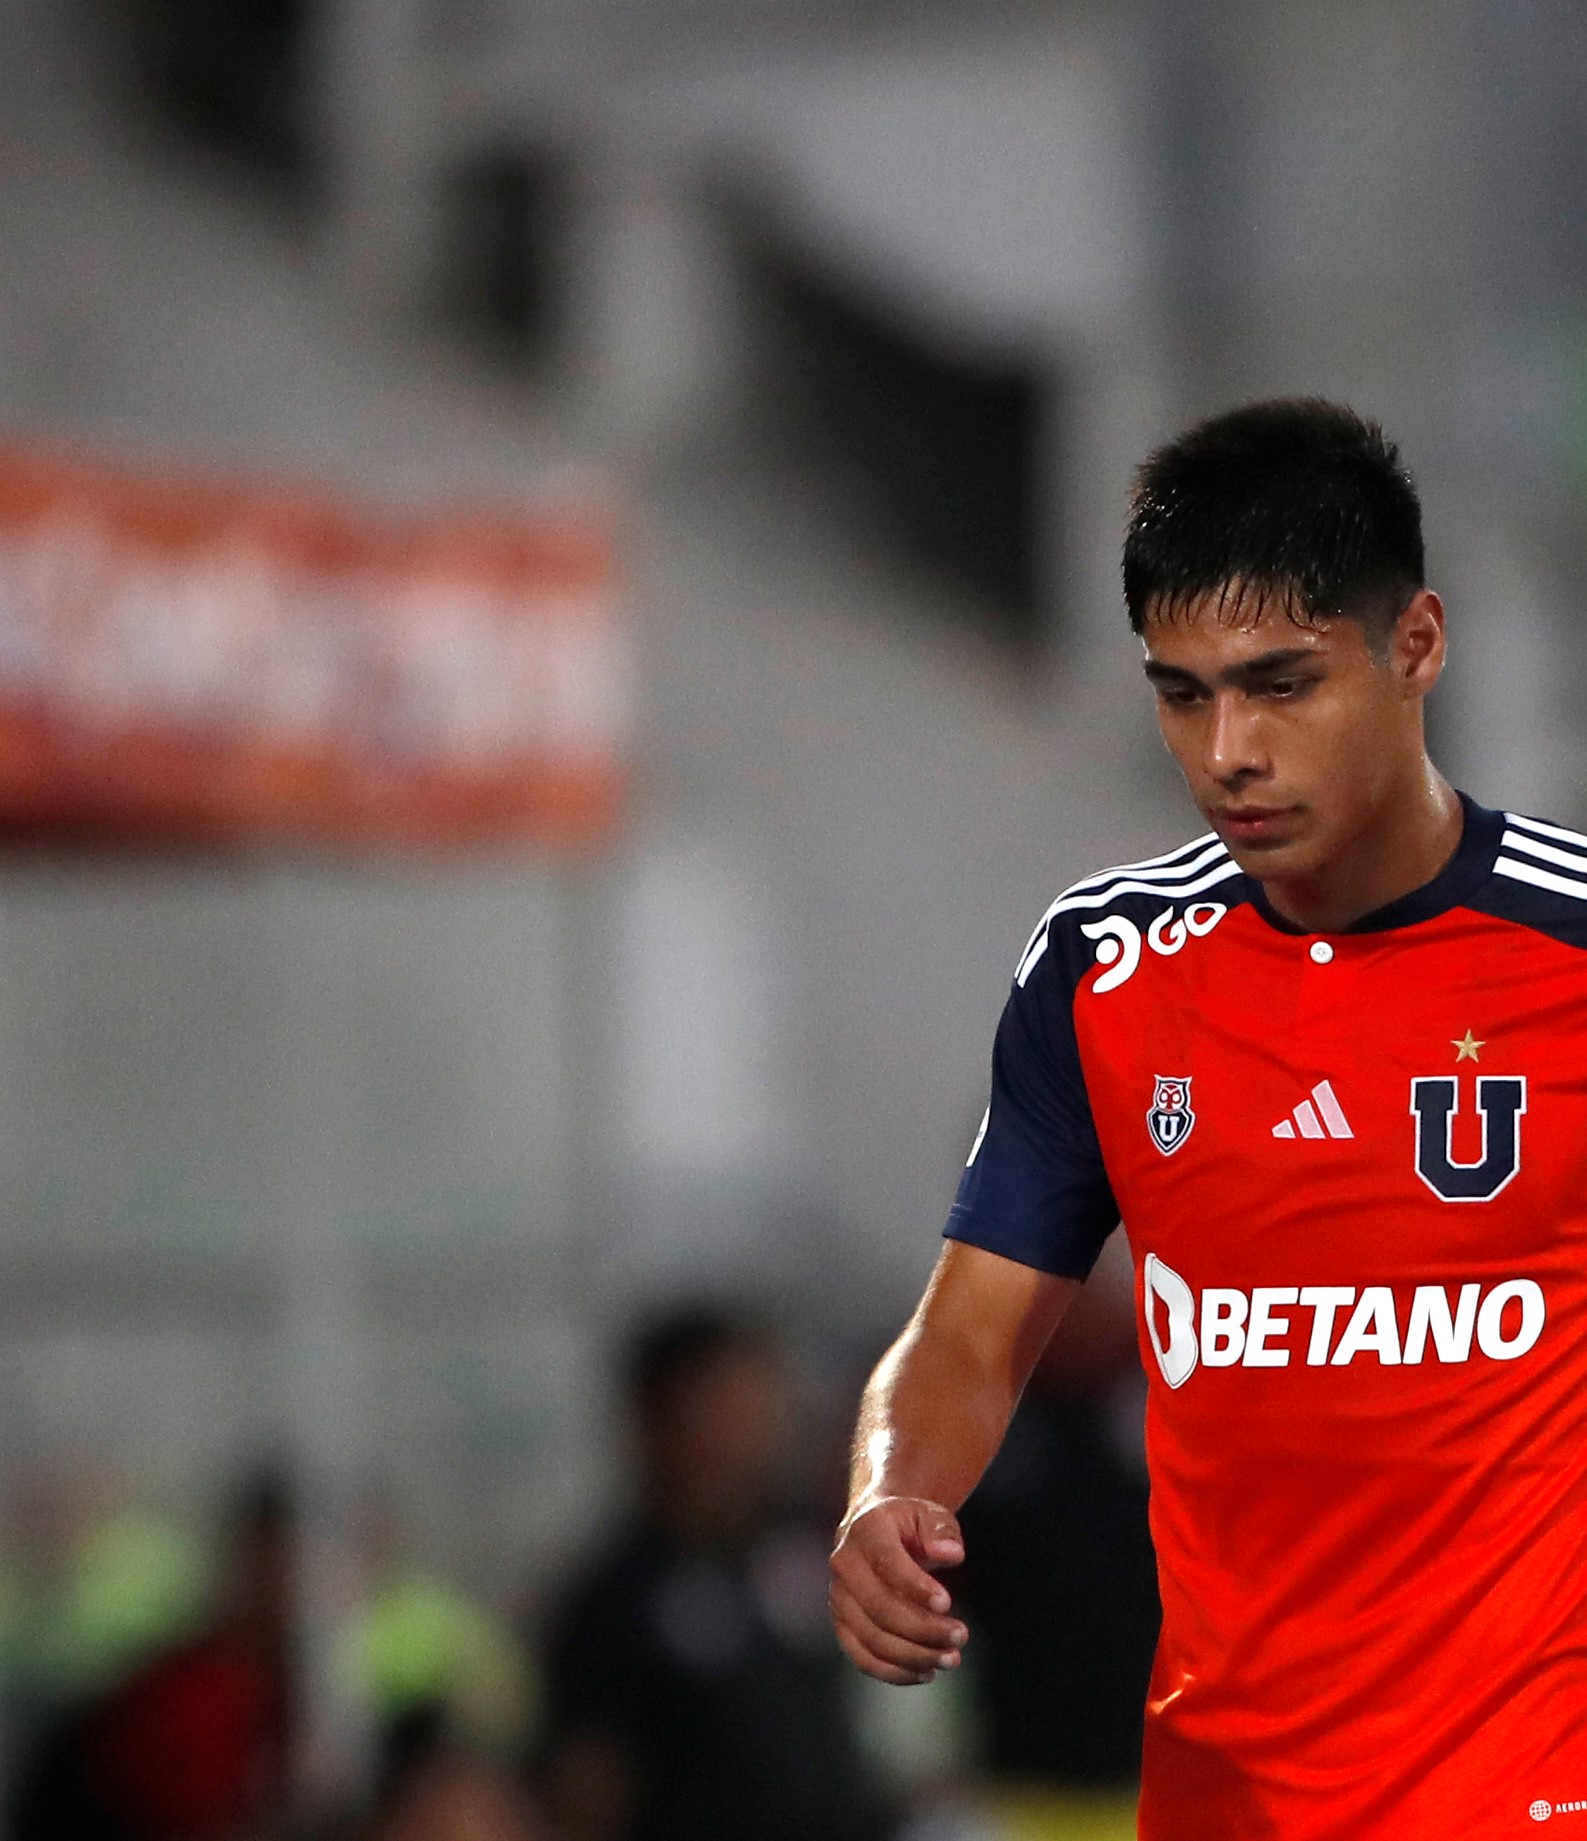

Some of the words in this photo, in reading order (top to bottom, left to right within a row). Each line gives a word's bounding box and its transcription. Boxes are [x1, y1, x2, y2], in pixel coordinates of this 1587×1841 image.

[1158, 1115, 1180, 1142] U
[1409, 1075, 1527, 1202] U
[1200, 1278, 1546, 1367] BETANO
